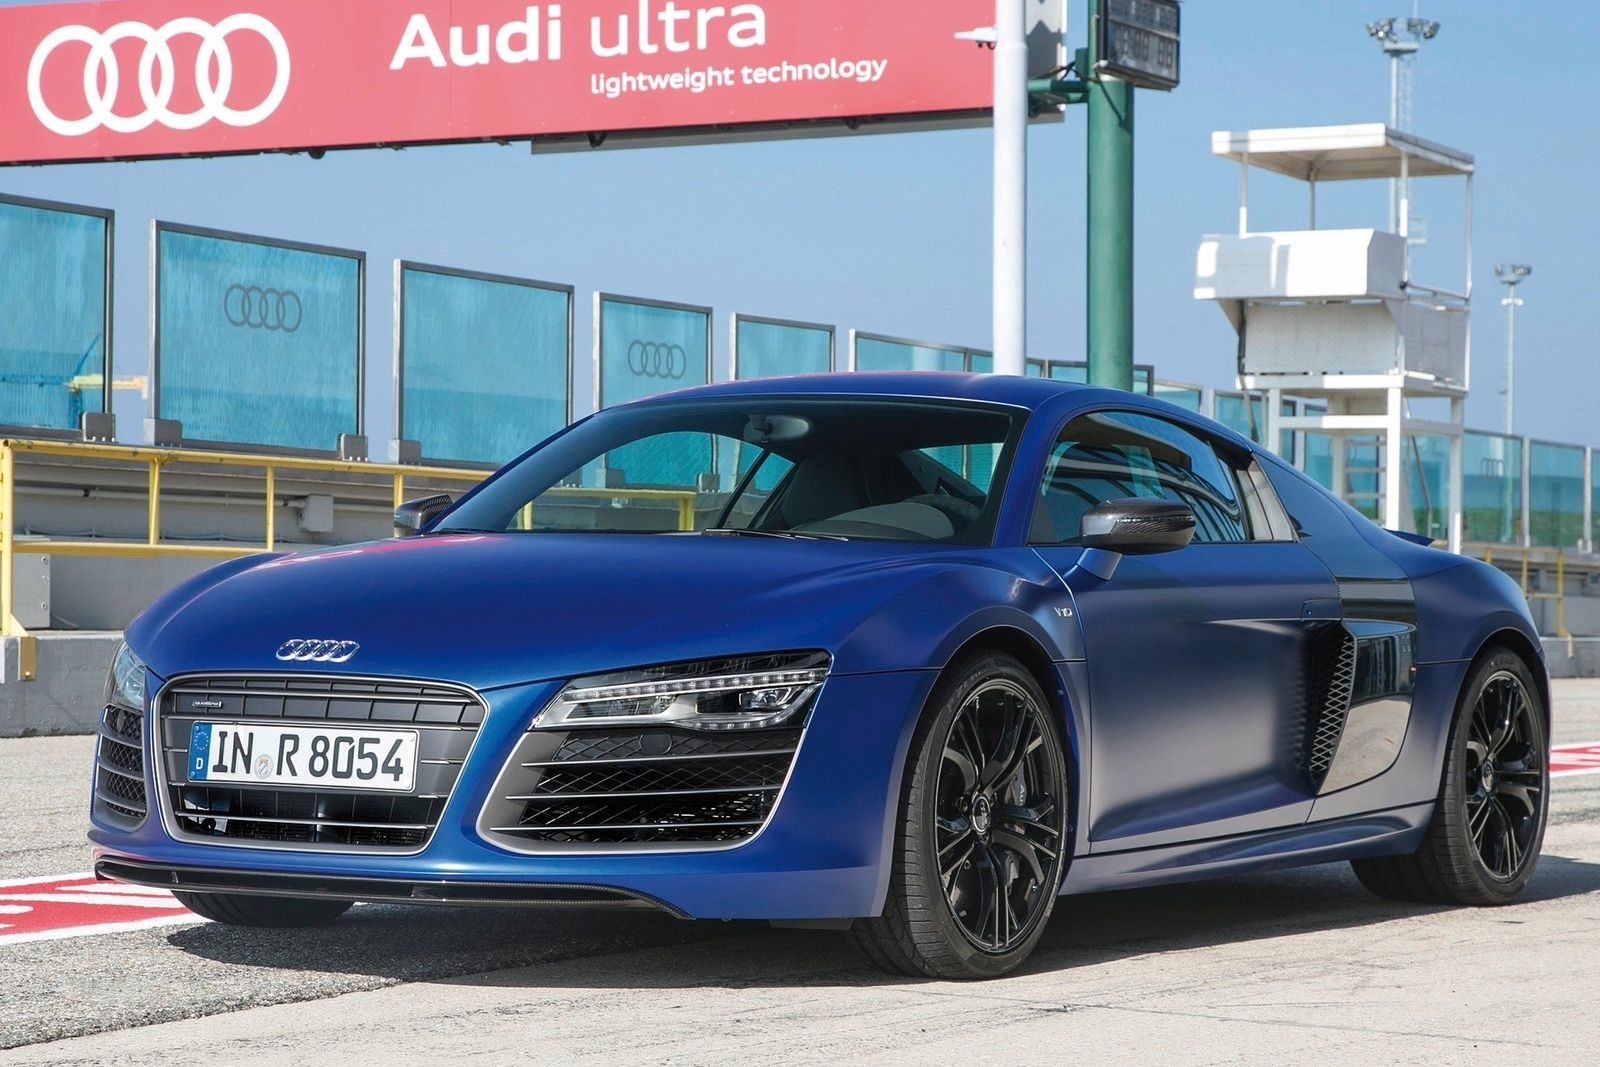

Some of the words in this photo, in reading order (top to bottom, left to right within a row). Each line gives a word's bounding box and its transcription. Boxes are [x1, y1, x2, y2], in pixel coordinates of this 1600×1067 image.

[389, 4, 561, 70] Audi
[590, 0, 766, 57] ultra
[591, 66, 734, 98] lightweight
[741, 58, 888, 83] technology
[1053, 606, 1073, 617] V10
[195, 757, 204, 770] D
[212, 731, 254, 774] IN
[276, 734, 300, 776] R
[308, 735, 404, 782] 8054
